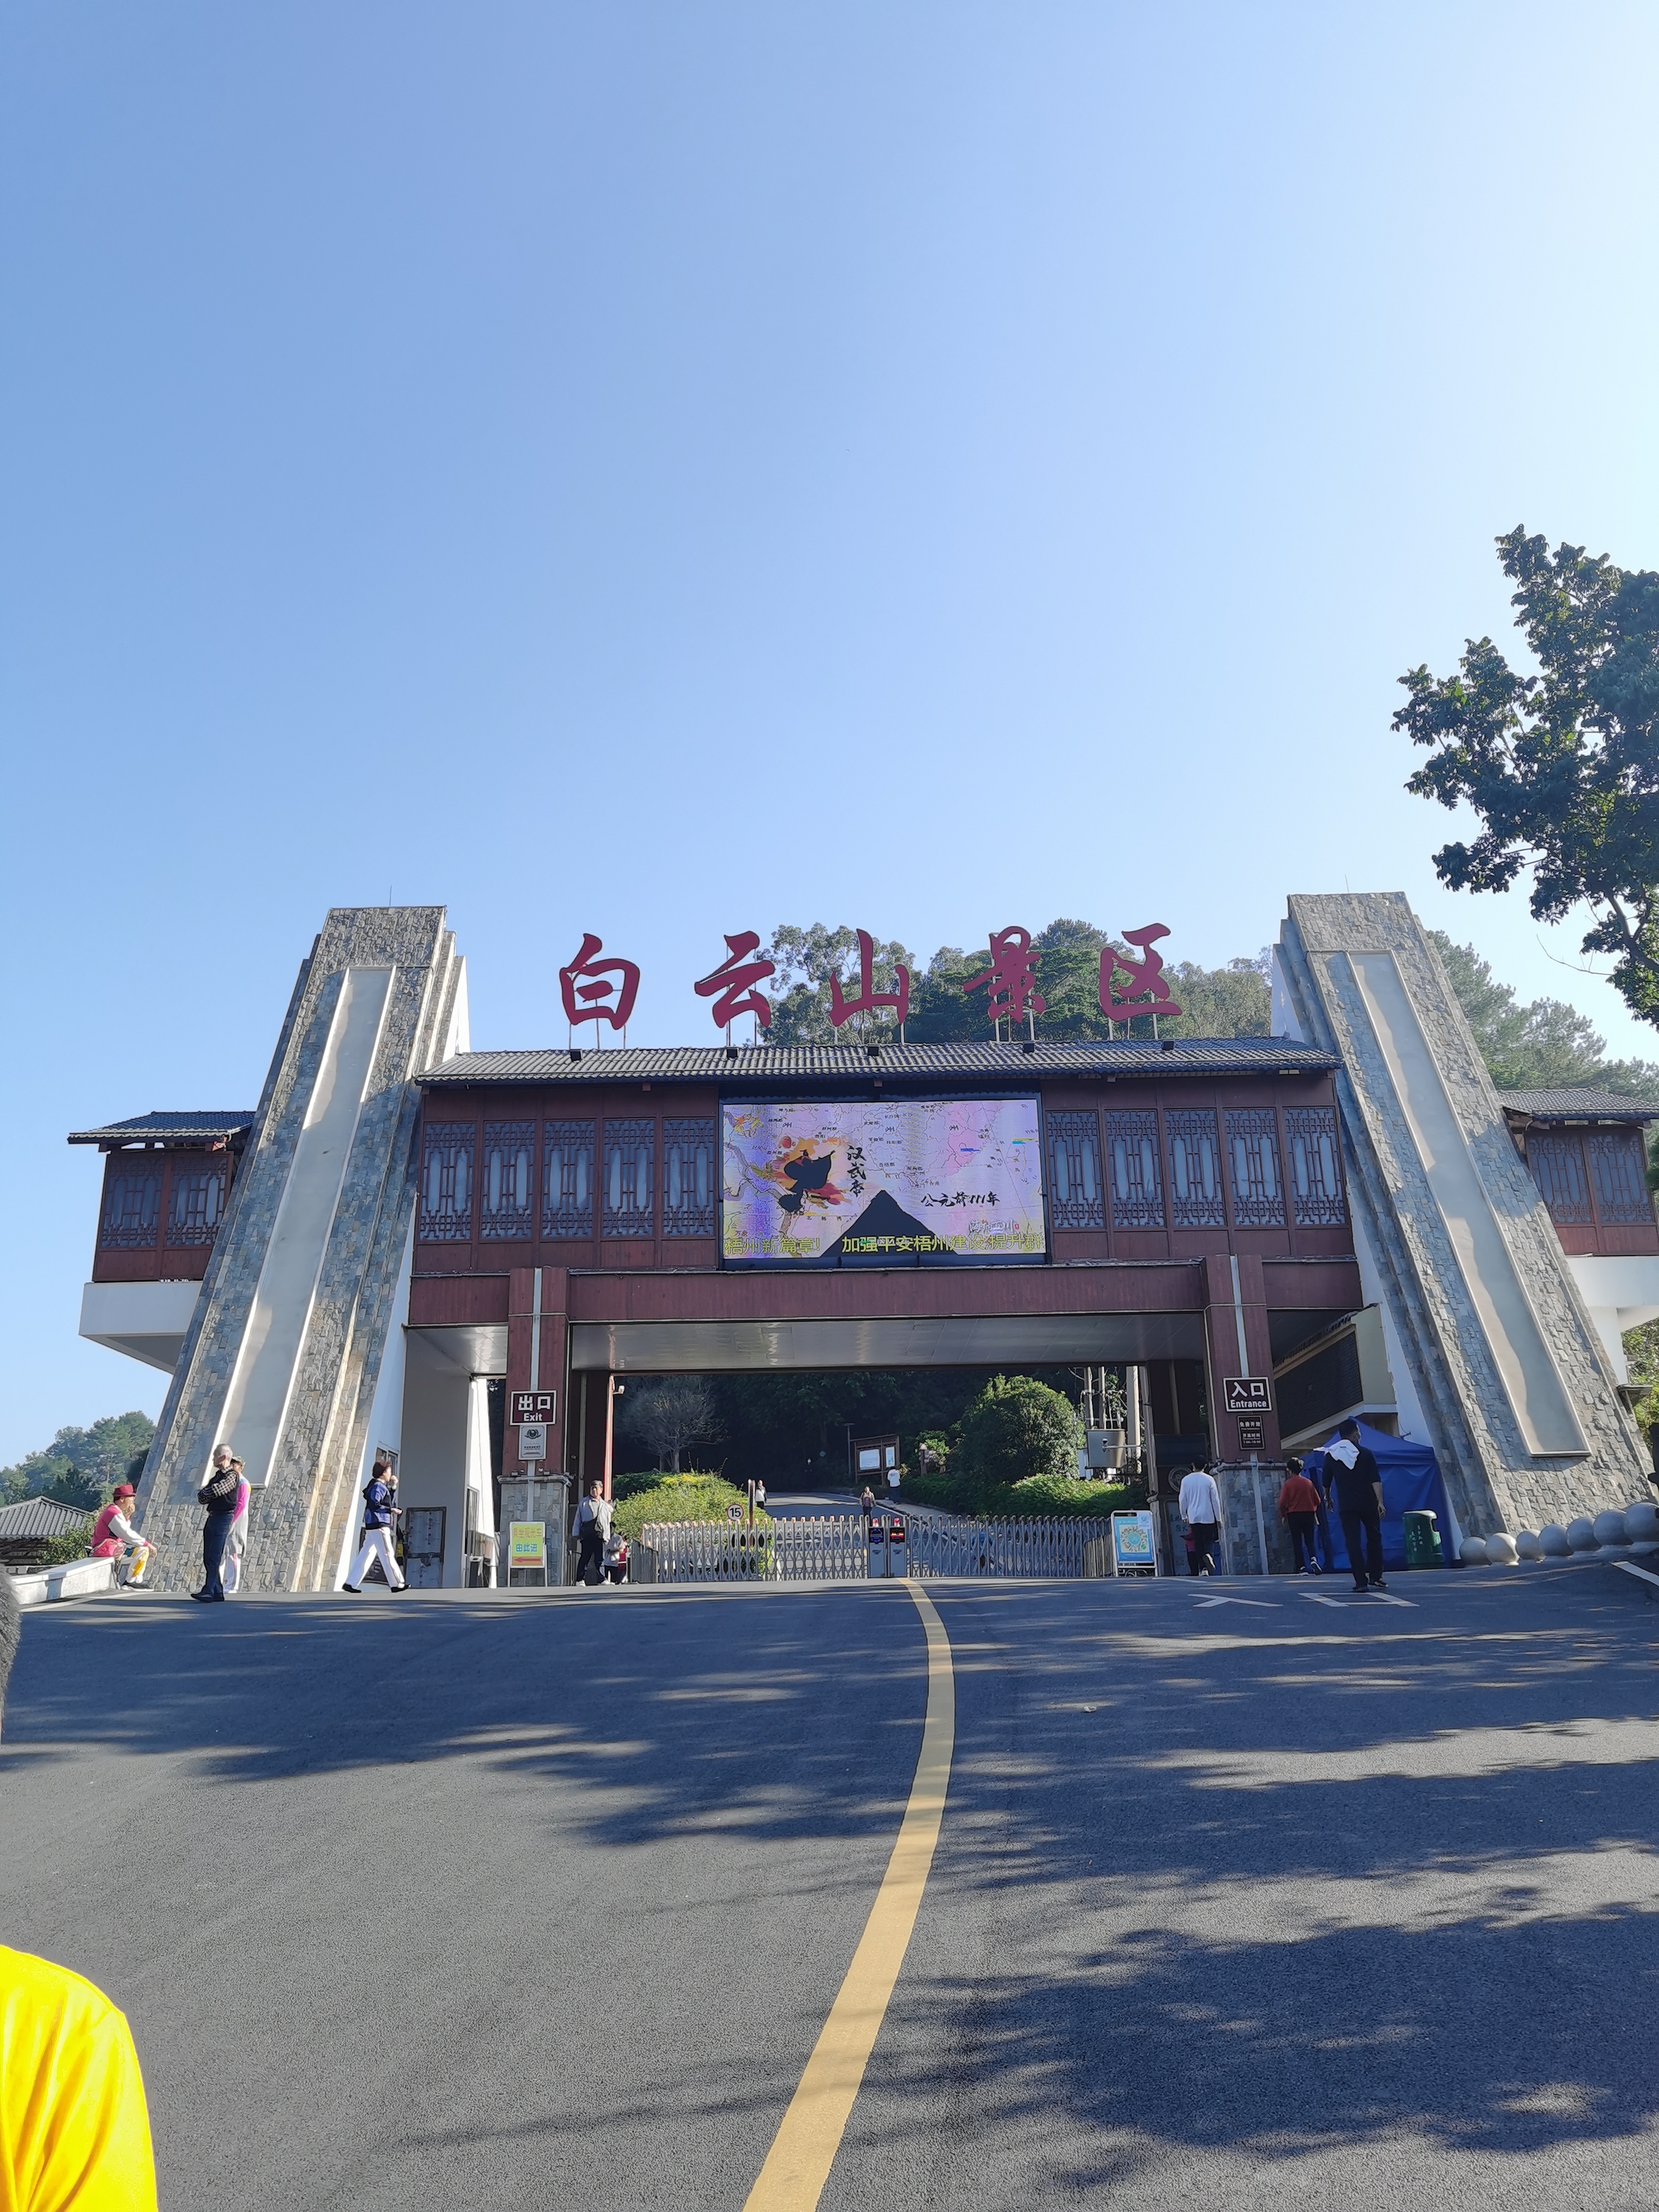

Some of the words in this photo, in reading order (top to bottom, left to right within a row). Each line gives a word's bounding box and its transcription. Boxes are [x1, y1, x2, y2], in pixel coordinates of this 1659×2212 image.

[559, 923, 1182, 1030] 白云山景区
[1232, 1382, 1264, 1397] 入口
[518, 1395, 551, 1411] 出口
[1230, 1399, 1267, 1408] Entrance
[524, 1412, 542, 1421] Exit
[729, 1507, 741, 1517] 15
